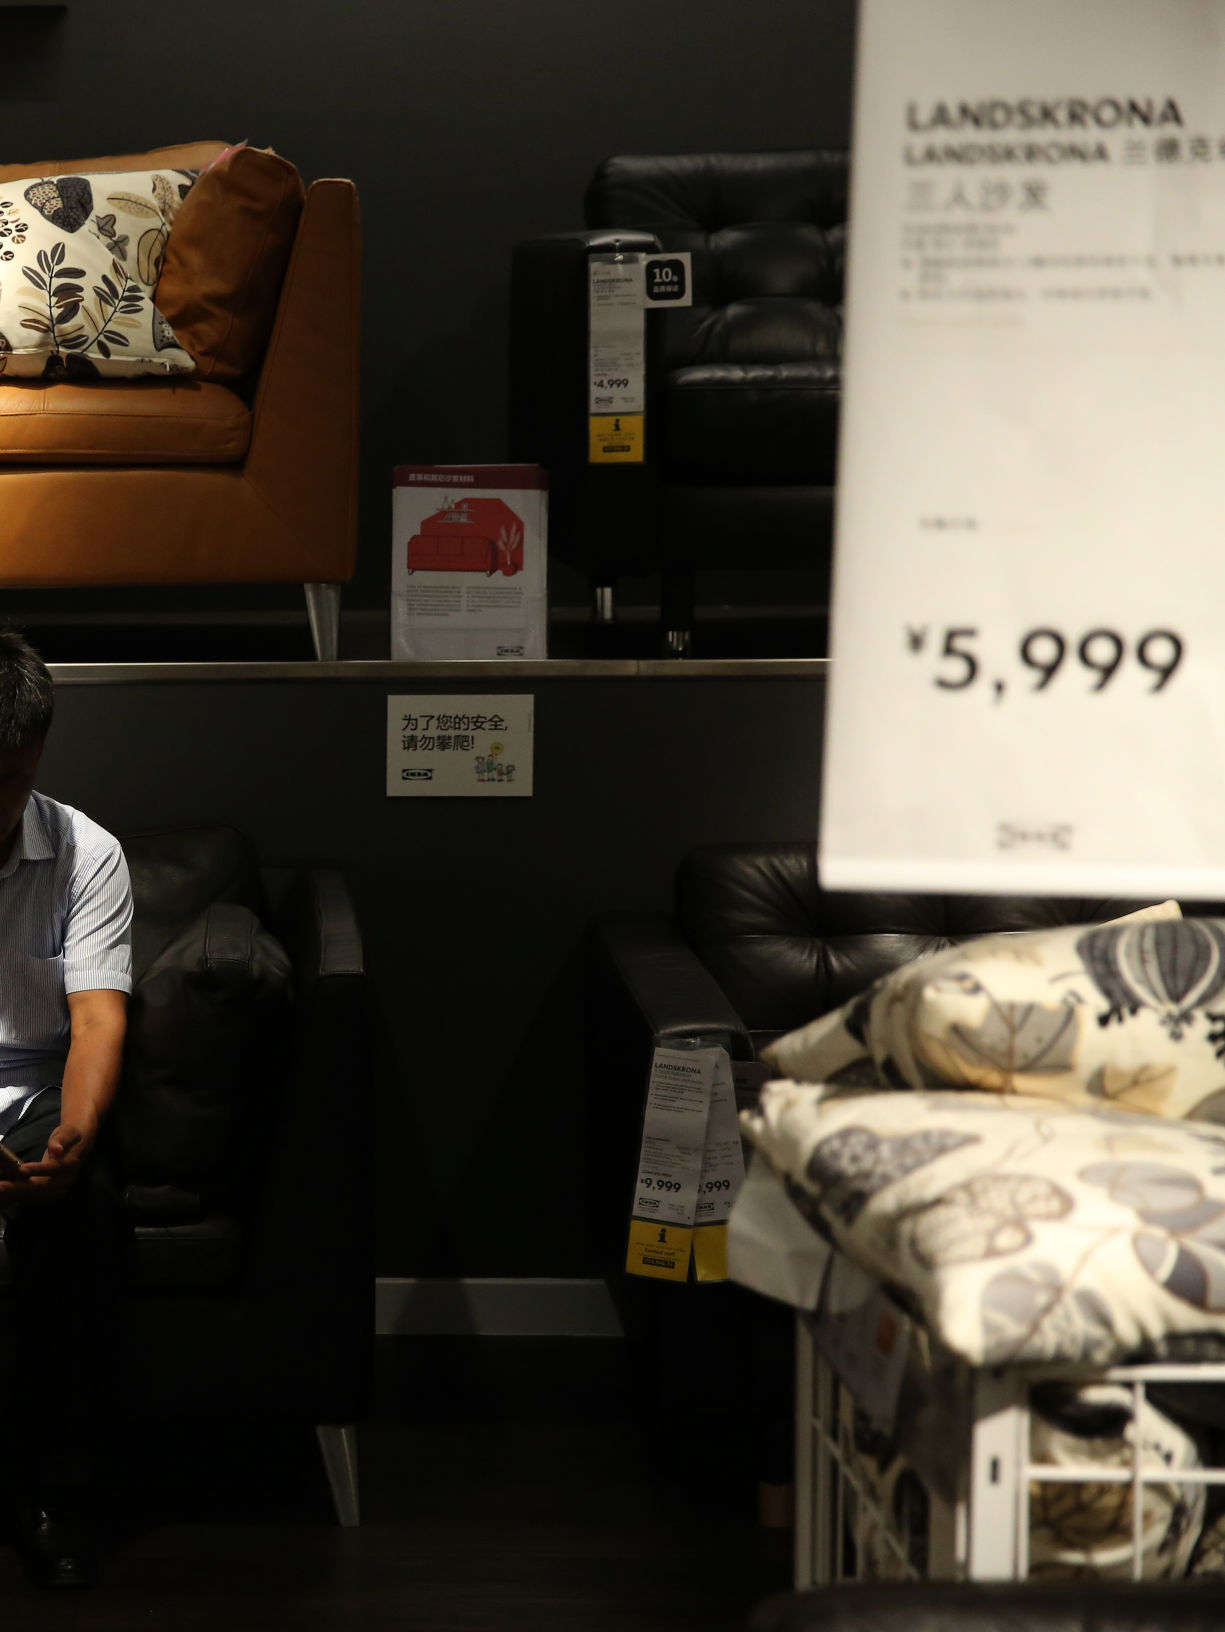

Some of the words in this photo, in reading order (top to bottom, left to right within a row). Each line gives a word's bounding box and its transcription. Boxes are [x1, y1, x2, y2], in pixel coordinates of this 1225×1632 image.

[906, 96, 1185, 132] LANDSKRONA
[903, 141, 1110, 168] LANDSKRONA
[906, 178, 1049, 215] 三人沙发
[906, 624, 1186, 707] ¥5,999
[402, 735, 475, 752] 请勿攀爬!
[655, 1062, 701, 1075] LANDSKRONA
[640, 1177, 681, 1193] ¥9,999
